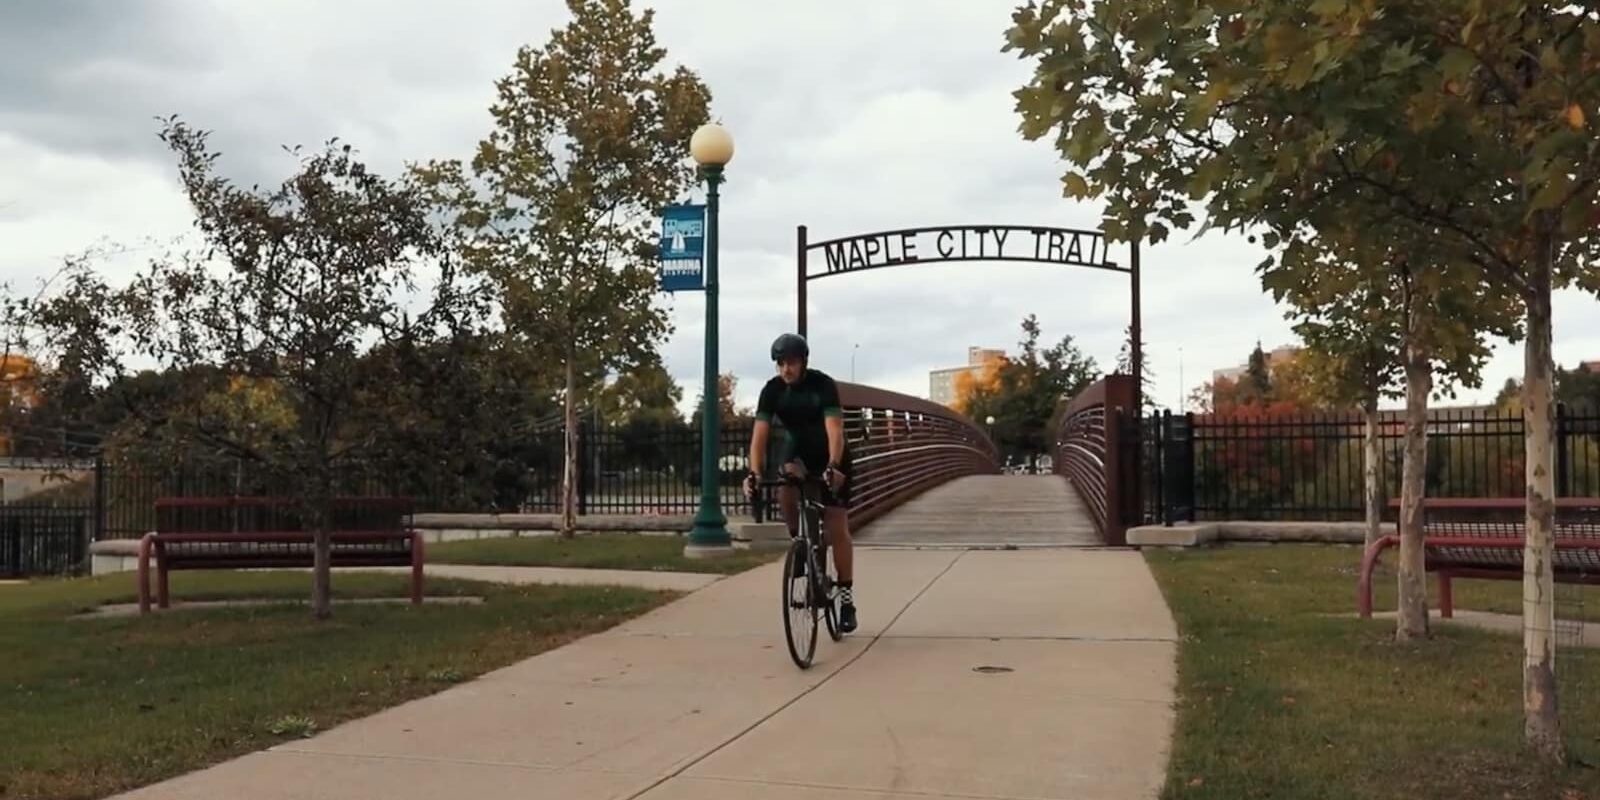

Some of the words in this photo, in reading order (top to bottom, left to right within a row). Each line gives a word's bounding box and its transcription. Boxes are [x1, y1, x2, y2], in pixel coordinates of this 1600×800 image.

[824, 231, 918, 272] MAPLE
[937, 229, 1009, 259] CITY
[1031, 231, 1118, 268] TRAIL
[662, 259, 701, 270] MARINA
